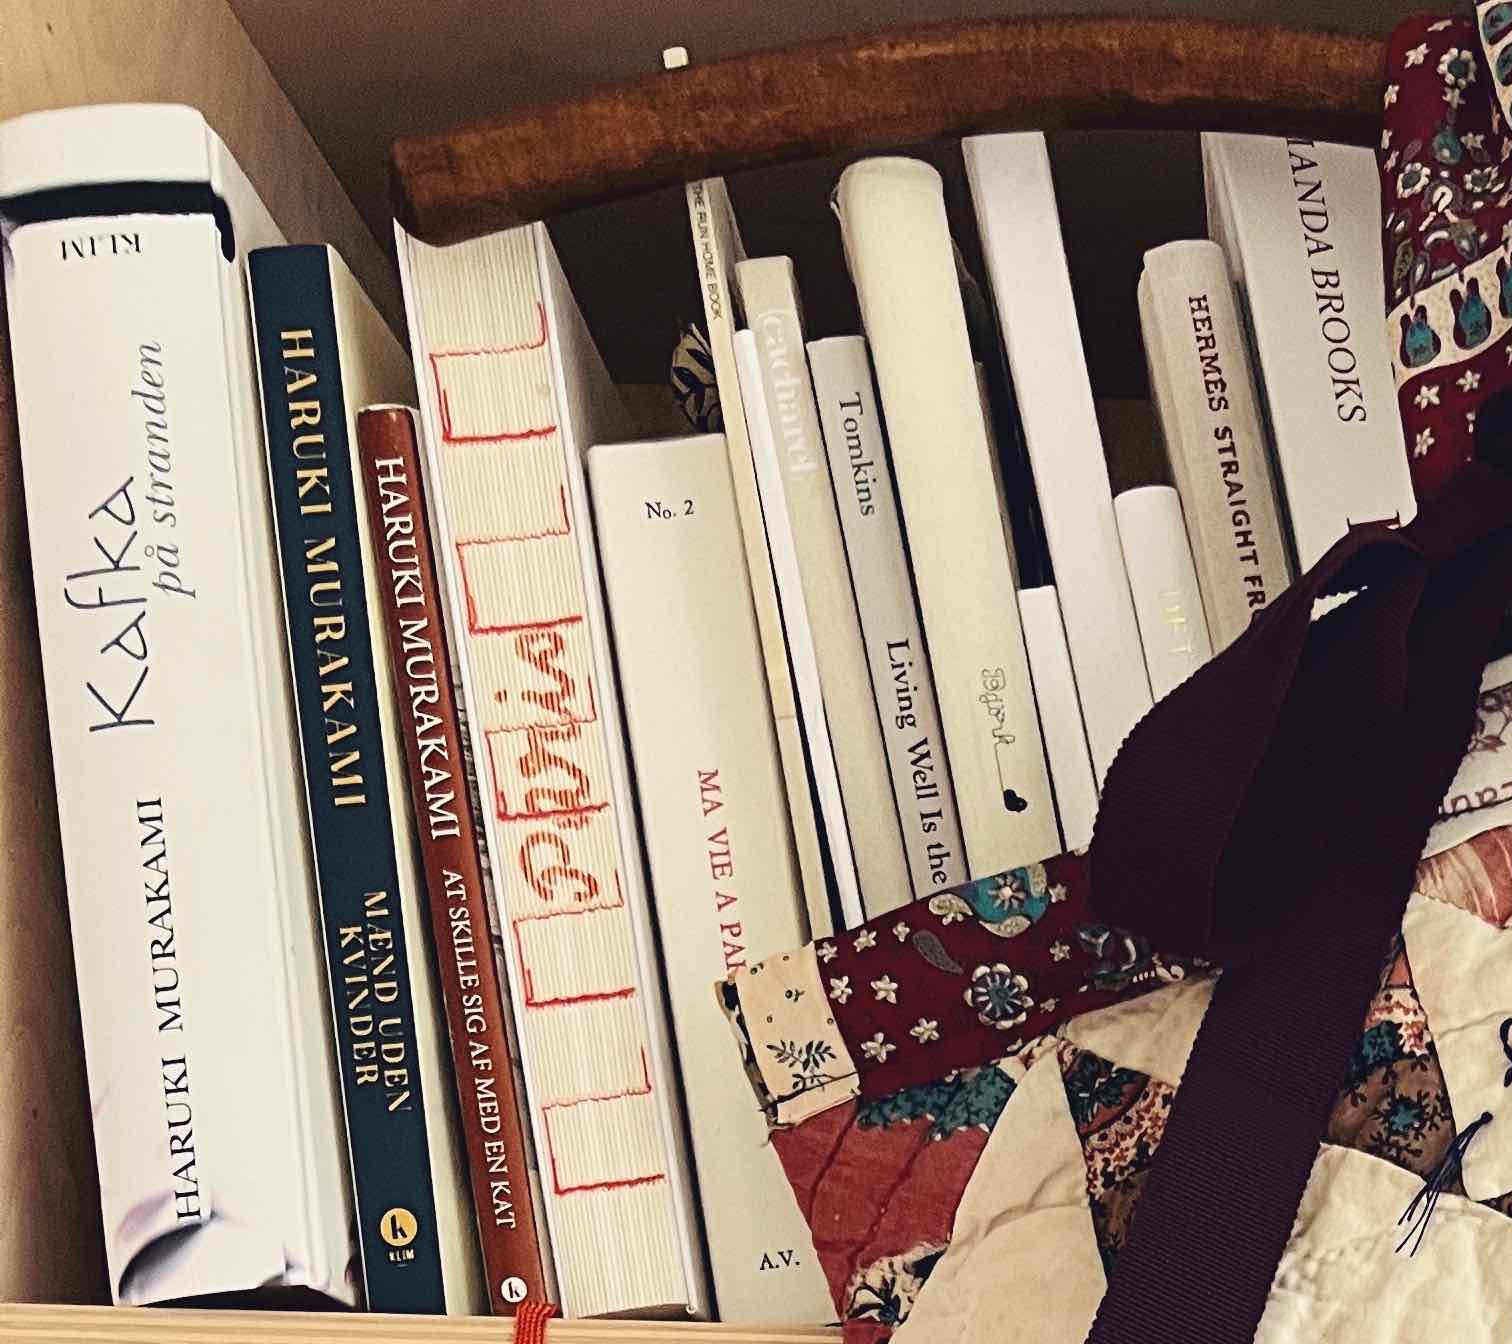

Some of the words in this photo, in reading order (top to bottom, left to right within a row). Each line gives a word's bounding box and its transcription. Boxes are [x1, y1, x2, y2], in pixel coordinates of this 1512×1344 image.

[61, 232, 143, 261] KLIM
[1312, 267, 1367, 424] BROOKS
[131, 341, 177, 528] stranden
[838, 391, 875, 517] Tomkins
[645, 500, 678, 520] No.
[683, 498, 695, 517] 2
[1215, 425, 1259, 565] STRAIGHT
[279, 328, 330, 518] HARUKI
[305, 535, 367, 807] MURAKAMI
[375, 456, 427, 608] HARUKI
[64, 476, 155, 732] Kafka
[144, 544, 196, 599] på
[886, 638, 918, 730] Living
[399, 620, 461, 842] MURAKAMI
[697, 769, 724, 817] MA
[907, 736, 939, 800] Well
[707, 828, 736, 878] VIE
[919, 809, 944, 835] Is
[442, 870, 466, 900] AT
[925, 841, 952, 885] the
[136, 797, 185, 1033] MURAKAMI
[716, 891, 739, 912] A
[363, 890, 398, 1003] MÆND
[448, 907, 479, 990] SKILLE
[339, 925, 378, 1085] KVINDER
[463, 994, 486, 1034] SIG
[378, 1017, 412, 1113] UDEN
[469, 1039, 492, 1071] AF
[159, 1055, 205, 1222] HARUKI
[475, 1076, 501, 1134] MED
[484, 1137, 507, 1172] EN
[490, 1174, 516, 1229] KAT
